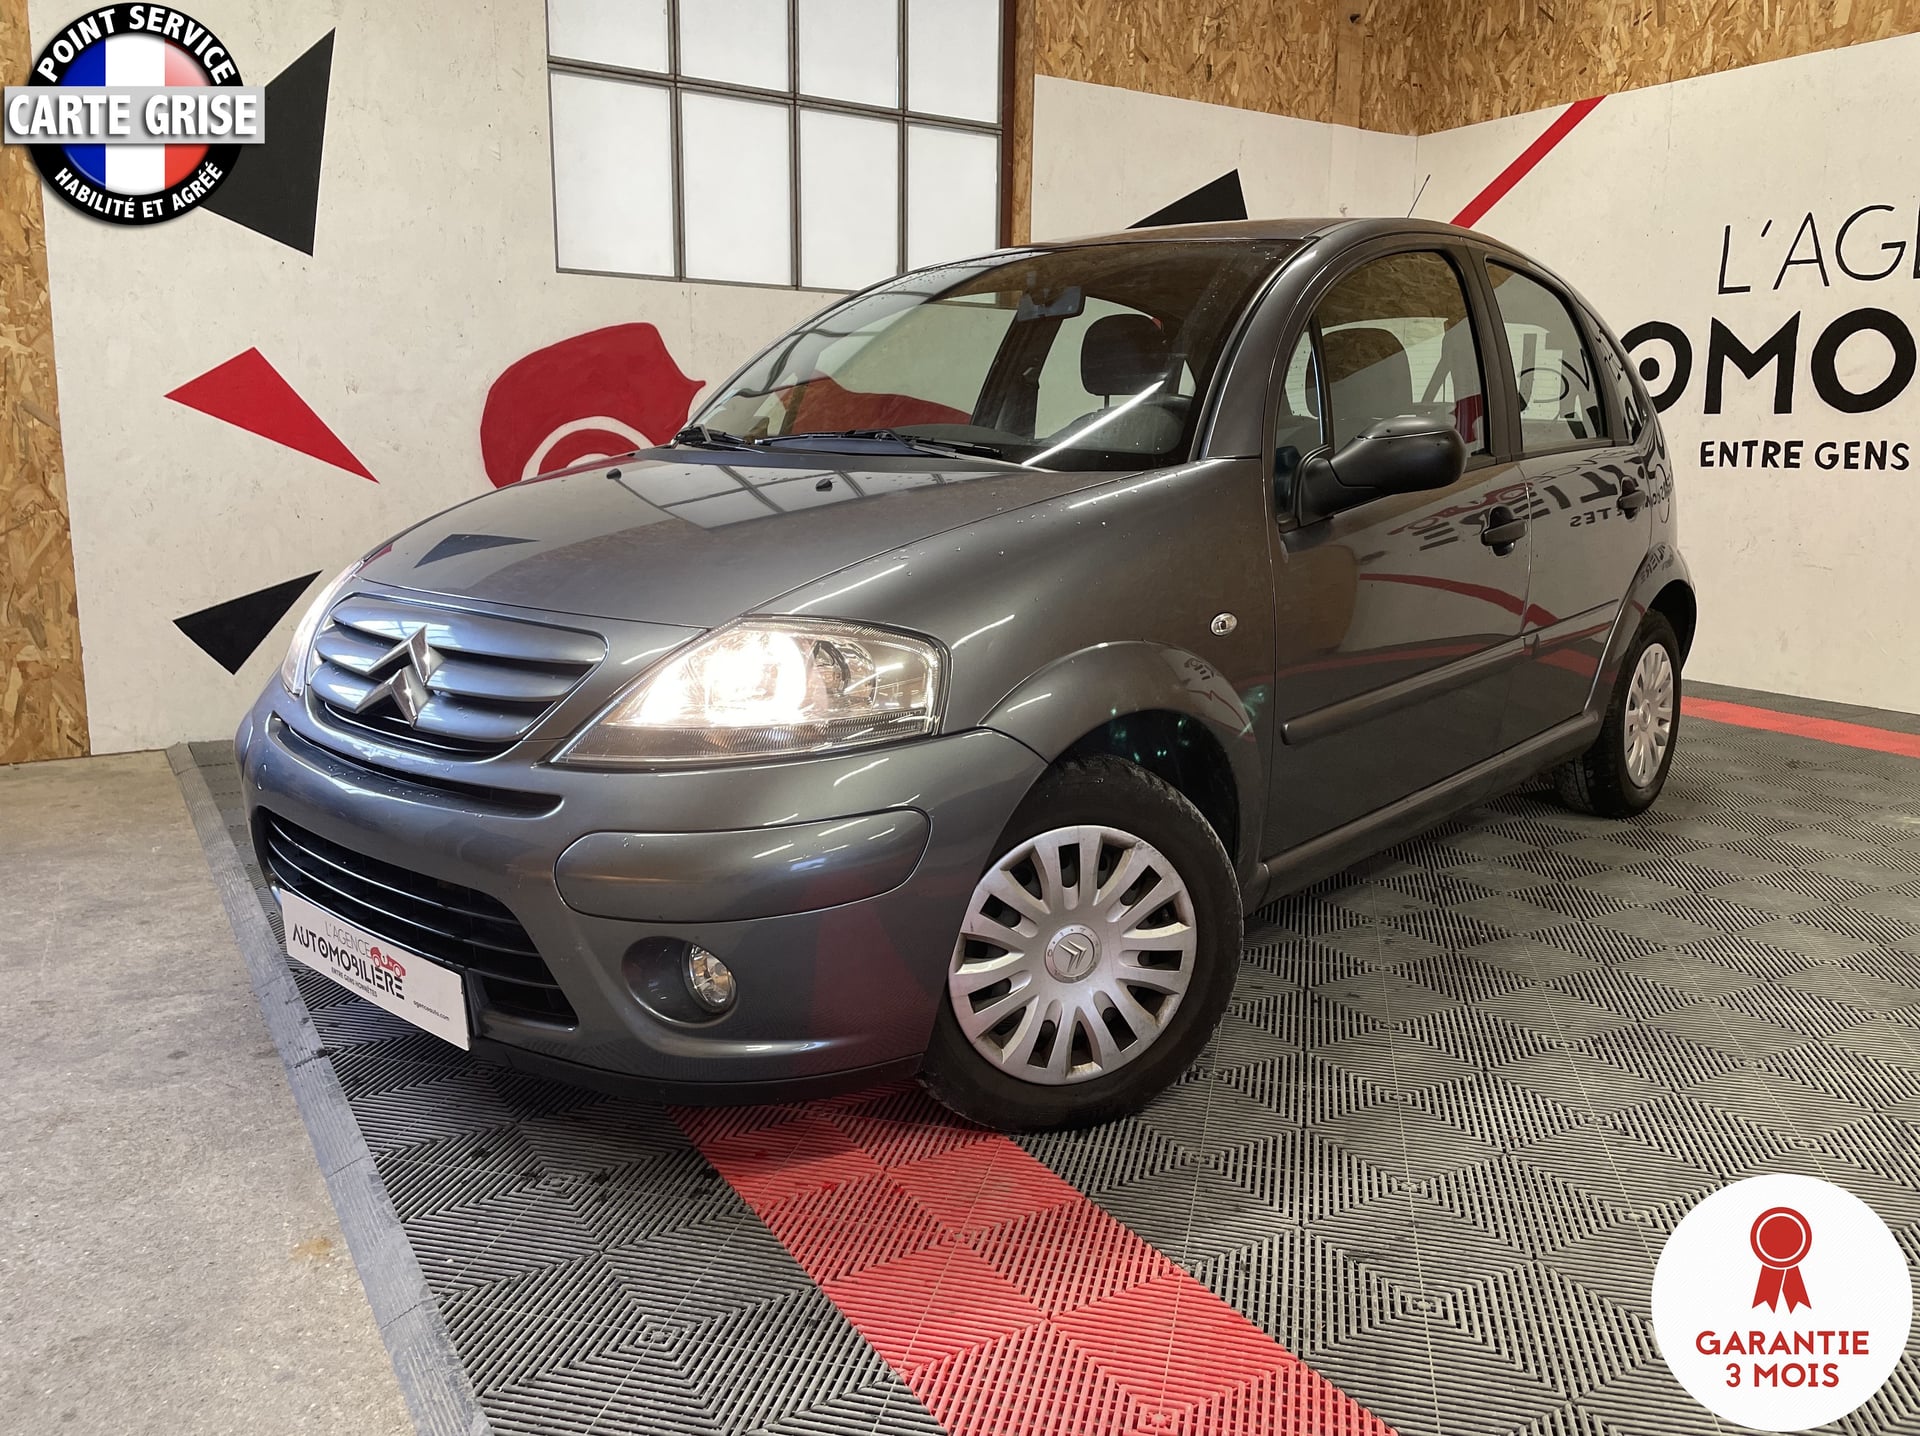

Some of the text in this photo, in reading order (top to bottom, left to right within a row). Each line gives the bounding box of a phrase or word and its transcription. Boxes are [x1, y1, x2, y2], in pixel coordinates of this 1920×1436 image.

[1700, 440, 1909, 470] ENTRE GENS
[325, 920, 372, 959] L'AGENCE
[331, 967, 344, 978] ENTRE
